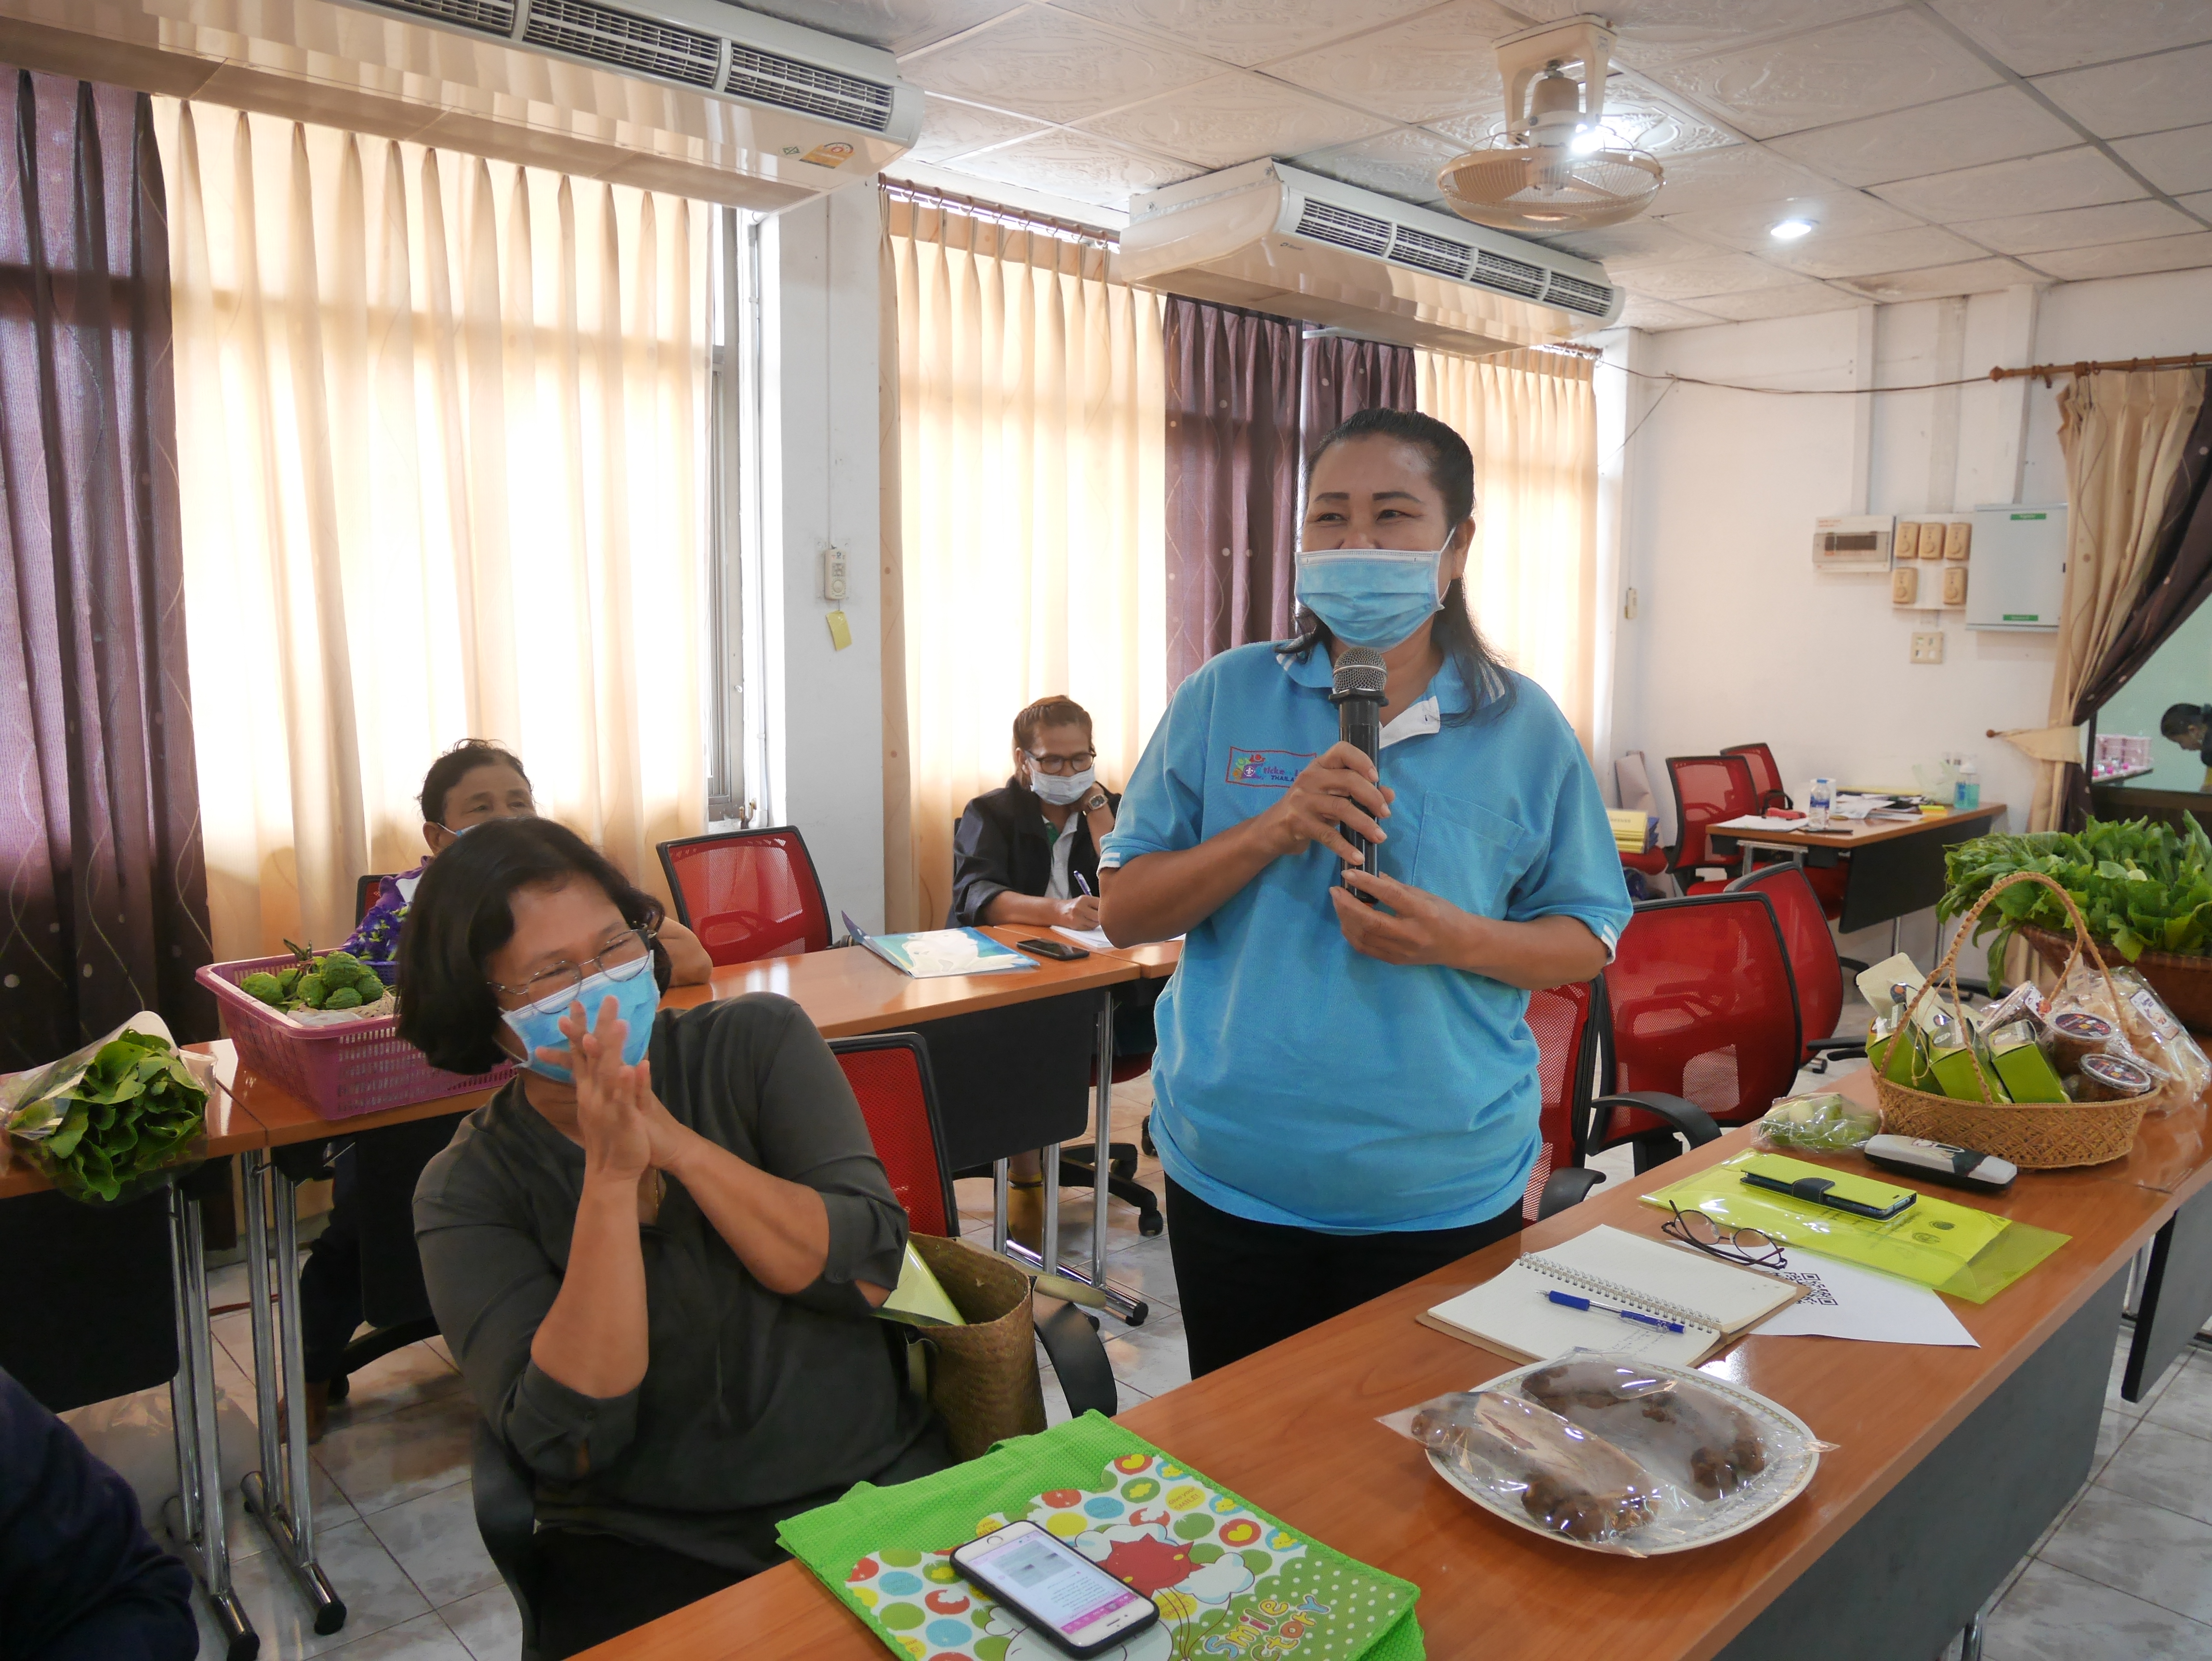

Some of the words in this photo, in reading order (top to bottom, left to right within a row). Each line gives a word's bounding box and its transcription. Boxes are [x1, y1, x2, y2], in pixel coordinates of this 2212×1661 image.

[1181, 1487, 1196, 1497] your
[1174, 1493, 1200, 1511] SMILE!
[1204, 1599, 1289, 1659] Smile
